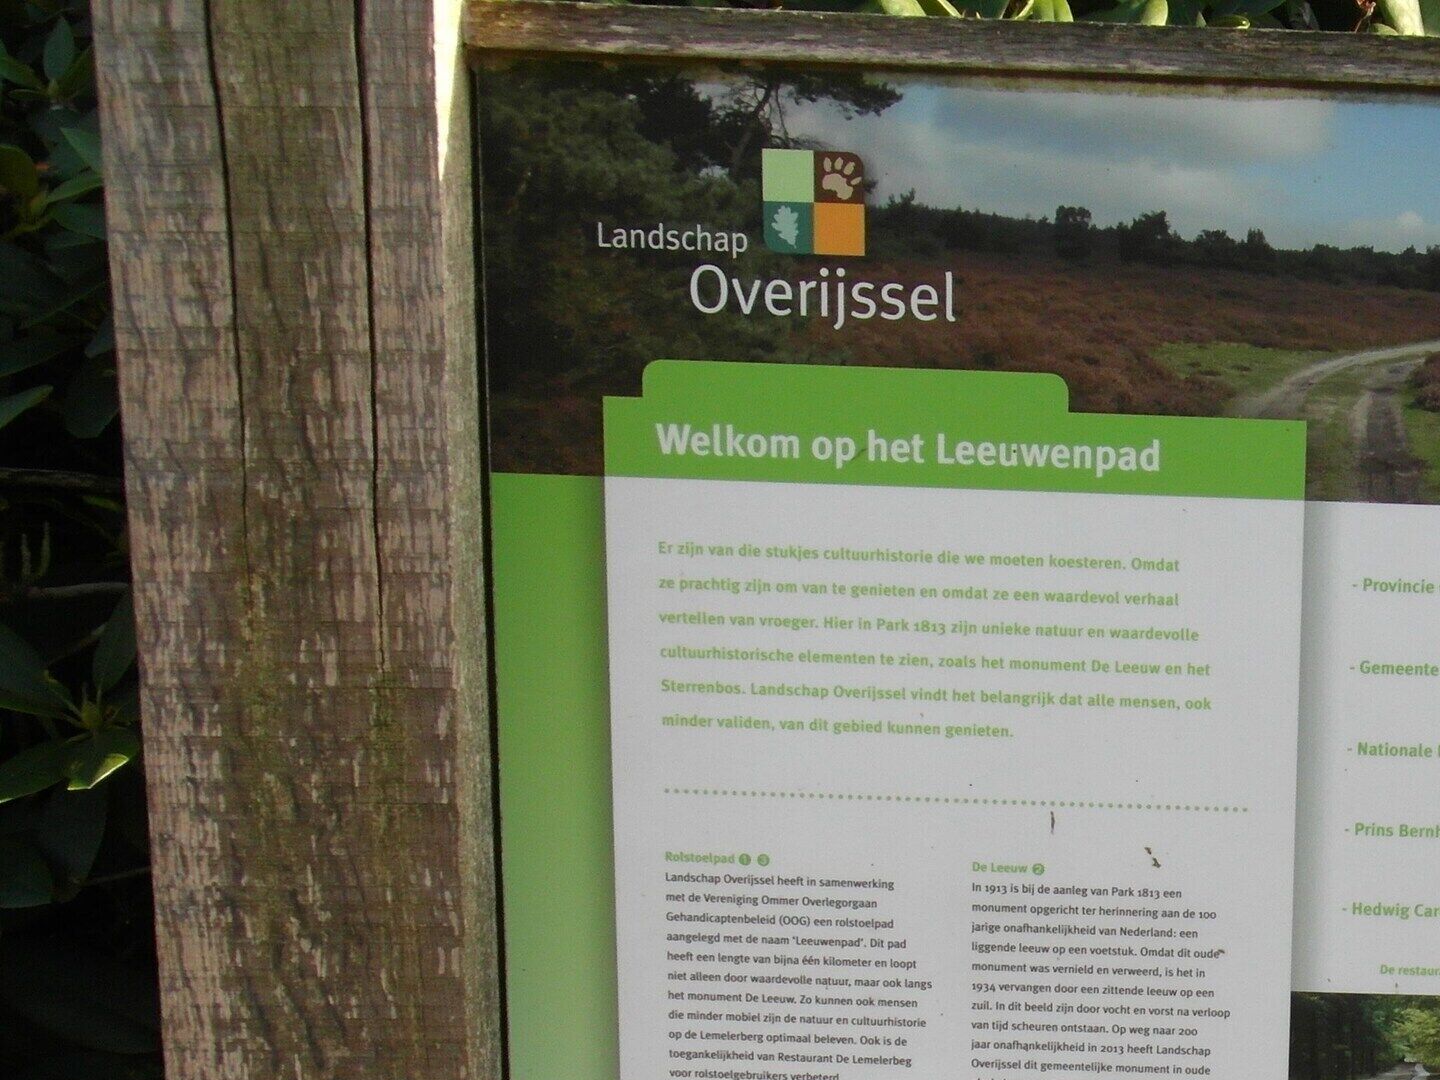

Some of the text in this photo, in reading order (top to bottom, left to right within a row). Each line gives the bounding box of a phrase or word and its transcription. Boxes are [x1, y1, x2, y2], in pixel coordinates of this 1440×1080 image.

[597, 222, 748, 258] Landschap
[690, 264, 956, 330] Overijssel
[655, 423, 1160, 477] Welkom op het Leeuwenpad
[658, 541, 1179, 571] Er zijn van die stukjes cultuurhistorie die we moeten koesteren. Omdat
[658, 577, 1178, 606] ze prachtig zijn om van te genieten en omdat ze een waardevol verhaal
[1362, 577, 1435, 593] Provincie
[658, 611, 1199, 641] vertellen van vroeger. Hier in Park 1813 zijn unieke natuur en waardevolle
[660, 645, 1210, 676] cultuurhistorische elementen te zien, zoals het monument De Leeuw en het
[1359, 660, 1439, 676] Gemeente
[661, 679, 1211, 710] Sterrenbos. Landschap Overijssel vindt het belangrijk dat alle mensen, ook
[662, 713, 1013, 738] minder validen, van dit gebied kunnen genieten.
[1357, 741, 1432, 757] Nationale
[1354, 822, 1393, 836] Prins
[664, 851, 735, 865] Rolstoelpad
[972, 861, 1028, 873] De Leeuw
[665, 872, 894, 890] Landschap Overijssel heeft in samenwerking
[666, 893, 877, 909] met de Vereniging Ommer Overlegorgaan
[972, 904, 1026, 913] monument
[1030, 905, 1078, 916] opgericht
[1082, 906, 1096, 915] ter
[1098, 906, 1158, 919] herinnering
[1182, 909, 1195, 918] de
[1198, 911, 1216, 919] 100
[1352, 902, 1410, 919] Hedwig
